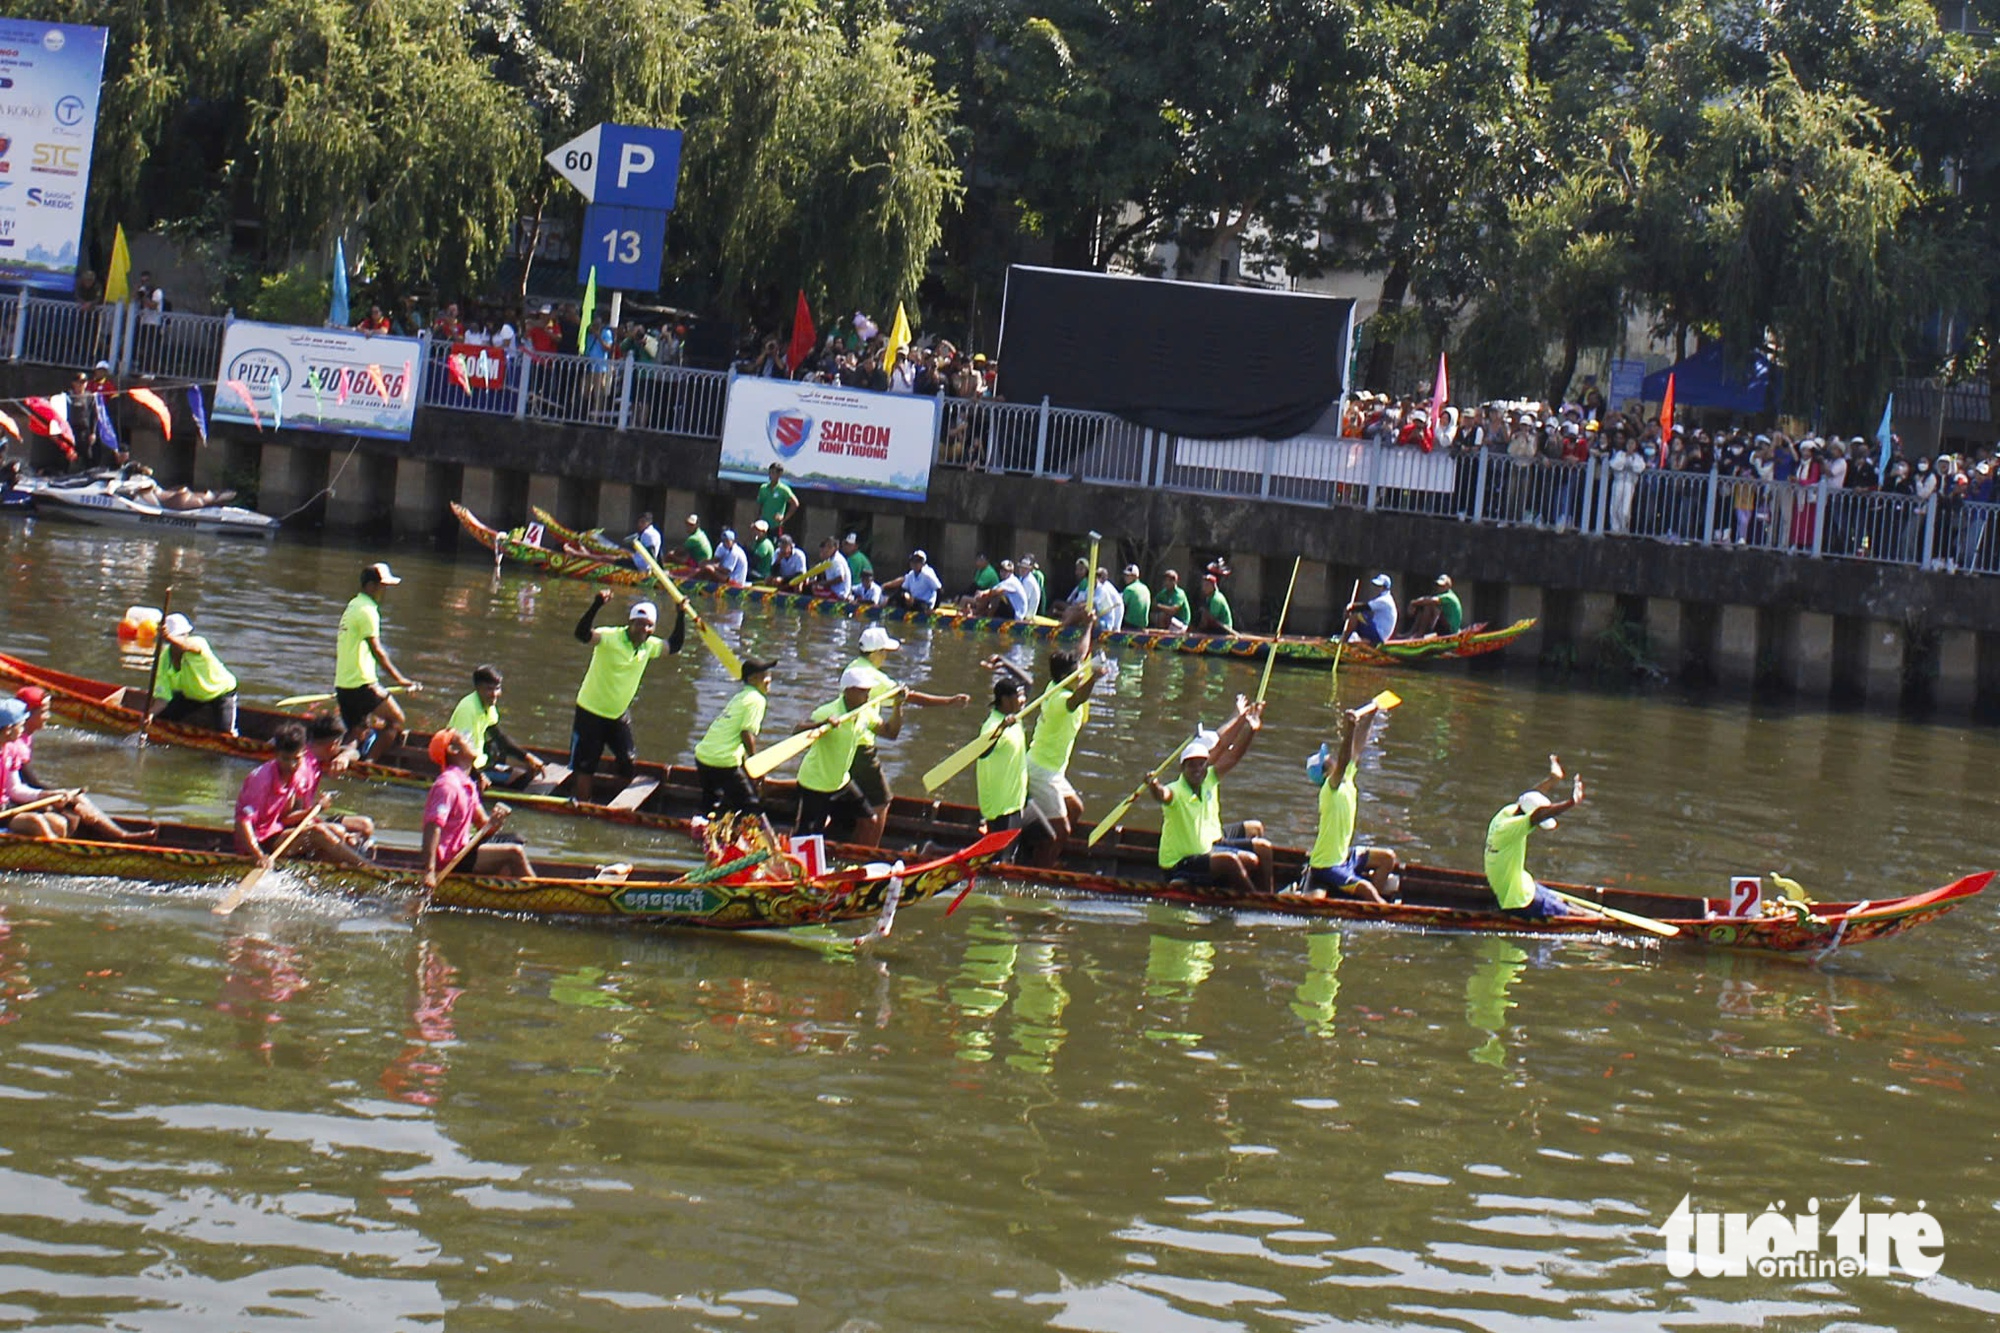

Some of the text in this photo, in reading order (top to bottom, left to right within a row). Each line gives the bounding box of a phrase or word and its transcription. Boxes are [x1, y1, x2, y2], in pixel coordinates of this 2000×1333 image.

[32, 143, 81, 168] STC
[565, 150, 593, 172] 60
[617, 143, 655, 188] P
[602, 229, 641, 264] 13
[238, 363, 279, 384] PIZZA
[820, 420, 891, 447] SAIGON
[818, 441, 844, 456] KINH
[797, 839, 817, 875] 1
[1735, 880, 1759, 916] 2
